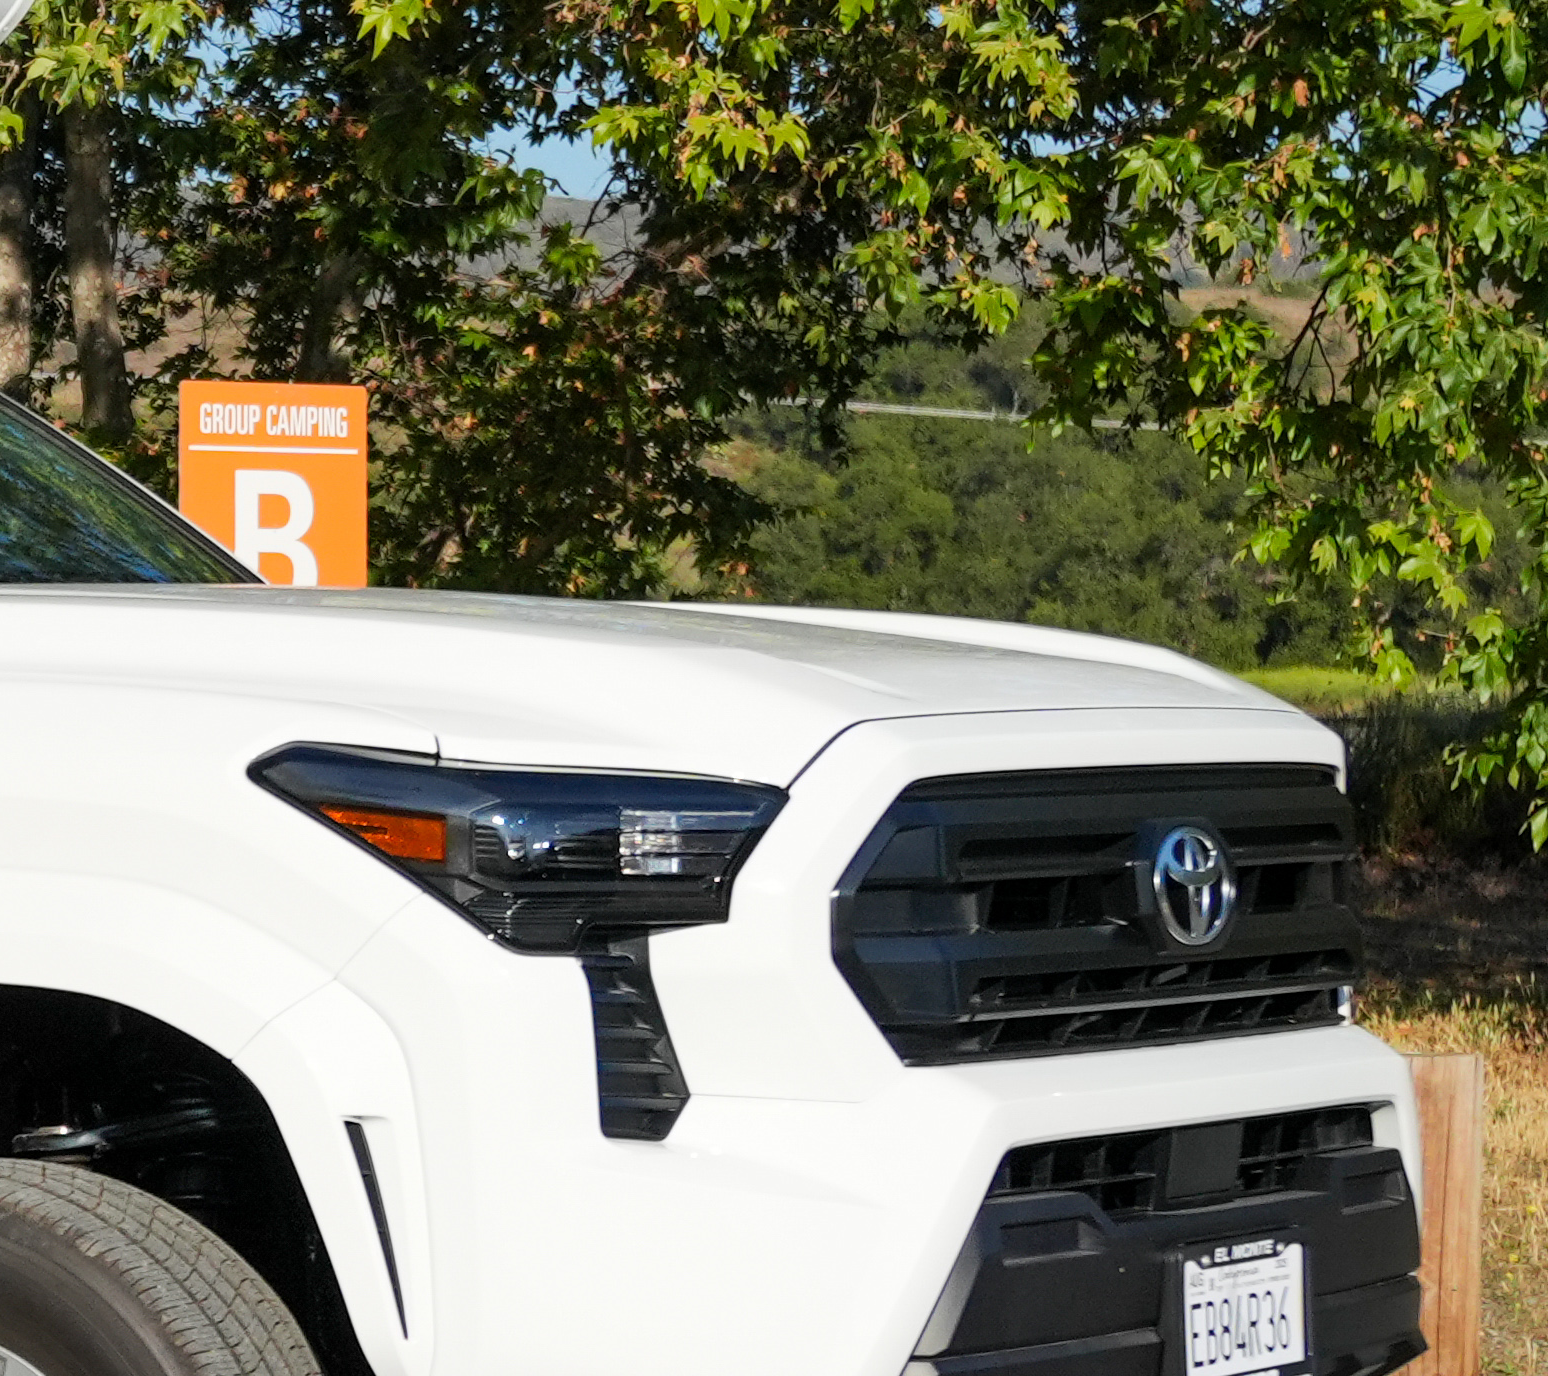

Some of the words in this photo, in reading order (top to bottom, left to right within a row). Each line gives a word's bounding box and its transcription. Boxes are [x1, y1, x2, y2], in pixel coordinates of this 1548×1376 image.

[199, 403, 261, 435] GROUP
[265, 405, 348, 438] CAMPING
[234, 469, 319, 586] B
[1191, 1286, 1291, 1368] EB84R36
